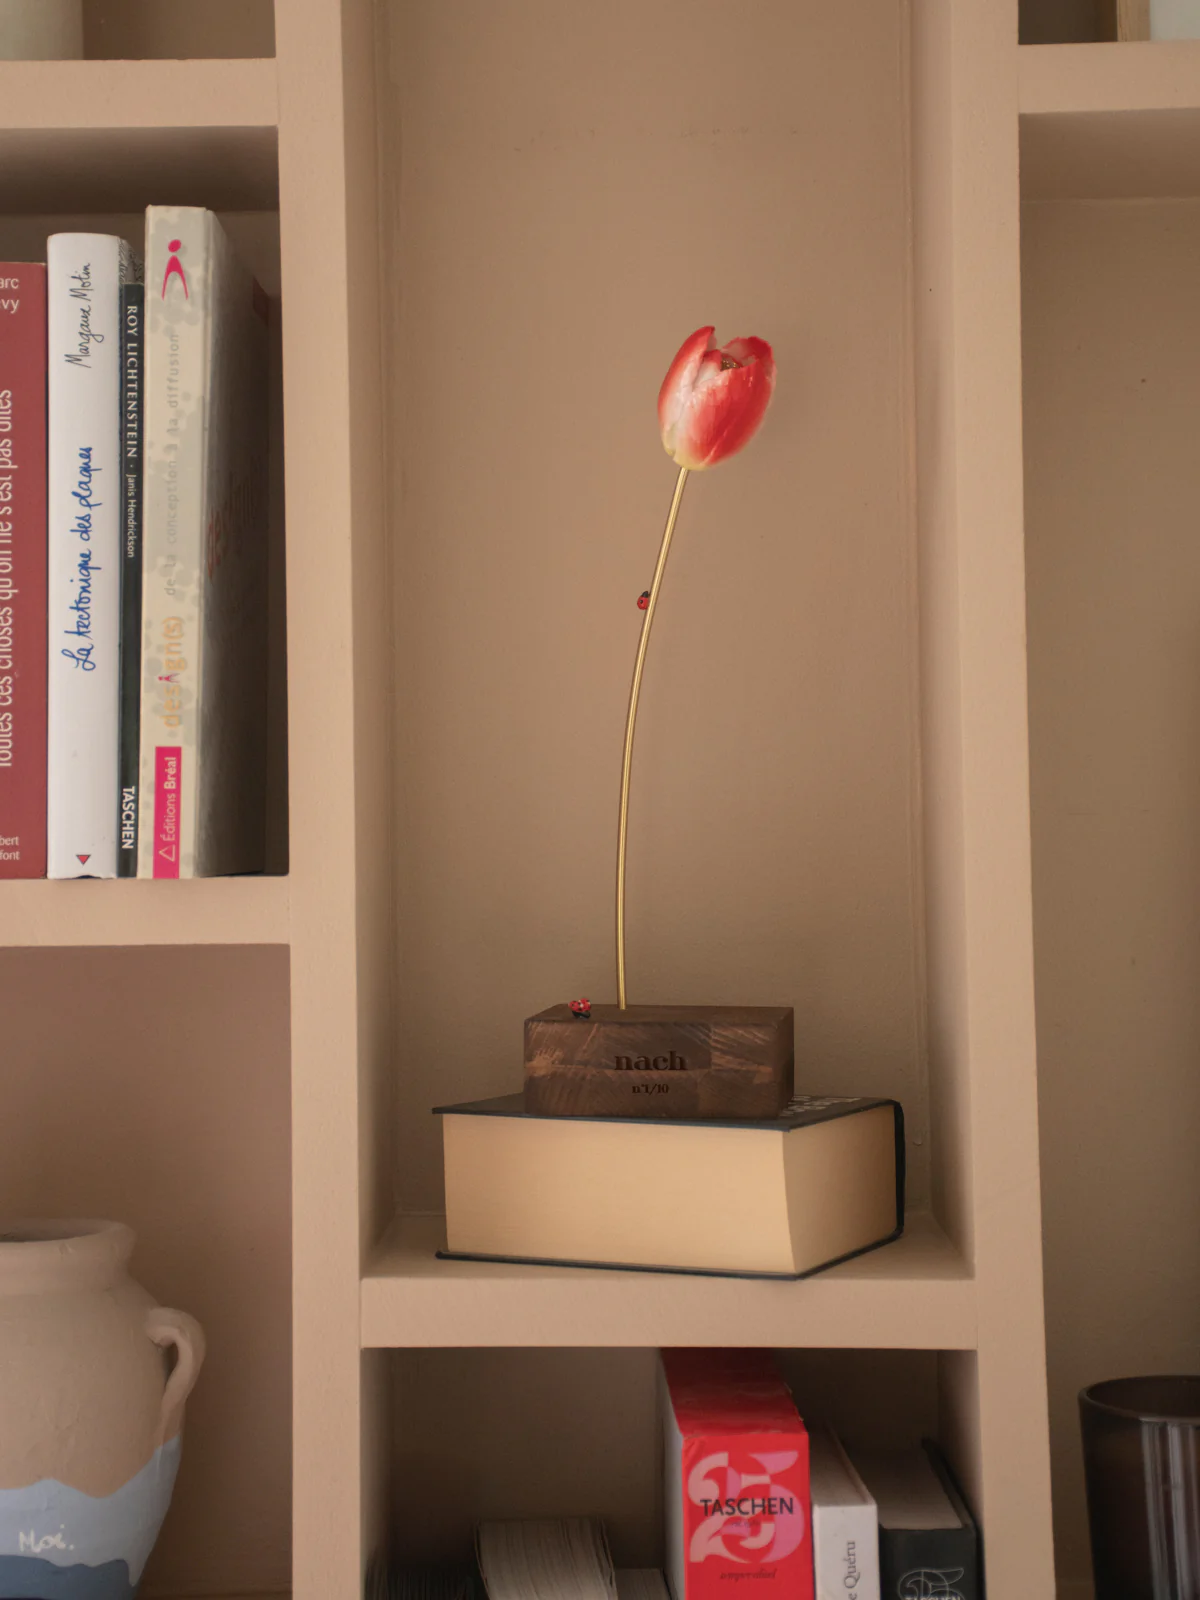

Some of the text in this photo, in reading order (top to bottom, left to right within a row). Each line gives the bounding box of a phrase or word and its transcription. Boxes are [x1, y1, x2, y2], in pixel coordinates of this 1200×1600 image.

[64, 262, 105, 369] Margaux Motin
[166, 333, 179, 409] diffusion
[125, 305, 138, 558] ROY LICHTENSTEIN Janis Hendrickson
[166, 418, 179, 433] la
[0, 438, 18, 469] pas
[165, 460, 179, 544] conception
[61, 446, 103, 672] La tectonique des plaques
[165, 554, 176, 568] la
[164, 579, 176, 596] de
[0, 676, 12, 706] ces
[121, 786, 135, 850] TASCHEN
[160, 756, 177, 842] Éditions Bréal
[614, 1050, 689, 1071] nach
[700, 1497, 794, 1517] TASCHEN
[843, 1541, 861, 1589] Quéru
